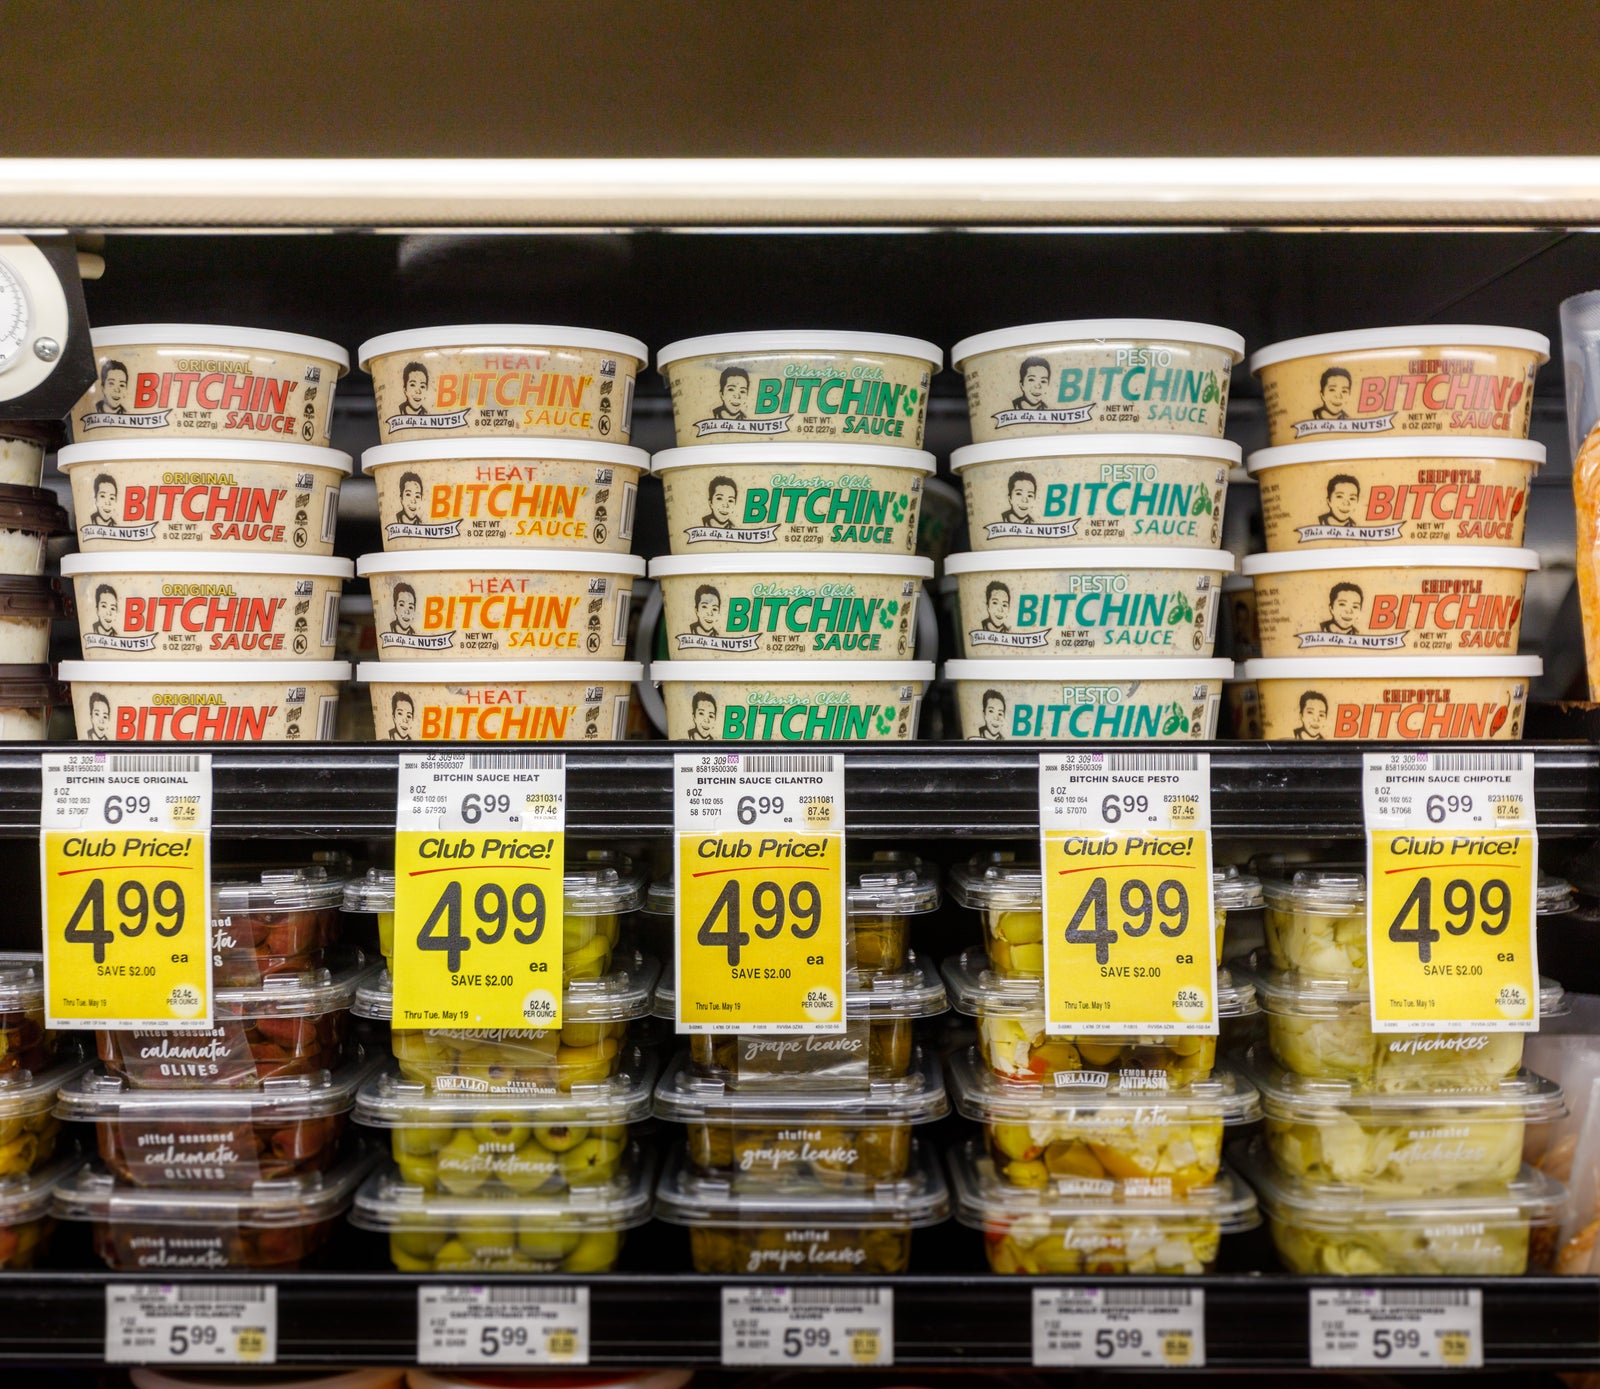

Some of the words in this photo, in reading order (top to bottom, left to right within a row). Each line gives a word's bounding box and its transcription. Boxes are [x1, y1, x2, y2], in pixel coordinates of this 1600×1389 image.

[178, 359, 252, 374] ORIGINAL
[484, 355, 544, 370] HEAT
[1116, 349, 1172, 367] PESTO
[784, 364, 847, 379] Cilantro
[852, 366, 884, 381] Chili
[1409, 360, 1475, 374] CHIPOTLE
[134, 372, 298, 414] BITCHIN'
[435, 372, 593, 409] BITCHIN'
[1058, 366, 1210, 403] BITCHIN'
[754, 378, 906, 417] BITCHIN'
[1357, 374, 1514, 413] BITCHIN'
[225, 411, 296, 434] SAUCE
[524, 409, 591, 428] SAUCE
[1001, 413, 1018, 423] This
[1021, 412, 1034, 422] dip
[1038, 412, 1047, 421] is
[1051, 411, 1085, 421] NUTS!
[1148, 404, 1207, 424] SAUCE
[1449, 411, 1510, 430] SAUCE
[843, 416, 904, 437] SAUCE
[163, 473, 237, 486] ORIGINAL
[477, 466, 537, 481] HEAT
[770, 474, 833, 488] Cilantro
[839, 475, 872, 489] Chili
[1101, 464, 1158, 482] PESTO
[1418, 469, 1481, 484] CHIPOTLE
[123, 486, 287, 523] BITCHIN'
[429, 483, 589, 519] BITCHIN'
[743, 488, 896, 525] BITCHIN'
[1043, 482, 1199, 517] BITCHIN'
[1366, 485, 1516, 521] BITCHIN'
[210, 523, 285, 542] SAUCE
[515, 521, 586, 538] SAUCE
[831, 525, 893, 543] SAUCE
[1133, 519, 1196, 536] SAUCE
[1457, 522, 1513, 539] SAUCE
[162, 584, 236, 596] ORIGINAL
[469, 578, 530, 593] HEAT
[752, 583, 816, 597] Cilantro
[820, 583, 856, 597] Chili
[1069, 575, 1128, 592] PESTO
[1422, 580, 1482, 594] CHIPOTLE
[124, 597, 286, 632] BITCHIN'
[422, 596, 580, 630] BITCHIN'
[726, 597, 884, 633] BITCHIN'
[1017, 593, 1176, 626] BITCHIN'
[1369, 594, 1514, 630] BITCHIN'
[210, 633, 284, 650] SAUCE
[478, 641, 499, 650] (227g)
[507, 631, 579, 648] SAUCE
[813, 633, 881, 650] SAUCE
[1104, 630, 1173, 645] SAUCE
[1459, 631, 1511, 648] SAUCE
[152, 694, 226, 705] ORIGINAL
[467, 690, 527, 704] HEAT
[746, 692, 810, 705] Cilantro
[815, 692, 851, 705] Chili
[1063, 687, 1122, 705] PESTO
[1383, 689, 1451, 703] CHIPOTLE
[116, 706, 278, 741] BITCHIN'
[420, 706, 577, 740] BITCHIN'
[722, 705, 880, 739] BITCHIN'
[1011, 704, 1171, 737] BITCHIN'
[1333, 703, 1497, 739] BITCHIN'
[433, 774, 473, 782] BITCHIN
[476, 774, 510, 782] SAUCE
[697, 777, 736, 785] BITCHIN
[739, 777, 771, 785] SAUCE
[775, 777, 823, 785] CILANTRO
[526, 794, 562, 802] 82310314
[799, 796, 834, 804] 82311081
[534, 806, 557, 815] 87.4¢
[808, 807, 830, 817] 87.4¢
[63, 838, 116, 857] Club
[123, 838, 192, 857] Price!
[419, 838, 475, 859] Club
[481, 838, 554, 859] Price!
[697, 838, 752, 858] Club
[759, 839, 828, 858] Price!
[1063, 837, 1118, 856] Club
[1125, 838, 1193, 856] Price!
[1390, 836, 1444, 855] Club
[1451, 837, 1520, 855] Price!
[97, 966, 126, 976] SAVE
[129, 966, 156, 977] $2.00
[530, 961, 547, 972] ea
[731, 969, 761, 979] SAVE
[764, 968, 791, 980] $2.00
[1100, 967, 1130, 977] SAVE
[1134, 966, 1161, 978] $2.00
[1424, 965, 1453, 976] SAVE
[1456, 965, 1482, 976] $2.00
[451, 975, 482, 986] SAVE
[485, 974, 513, 987] $2.00
[530, 1001, 550, 1010] 62.4¢
[808, 992, 827, 1002] 62.4¢
[443, 1011, 458, 1020] May
[523, 1010, 537, 1018] PER
[539, 1010, 556, 1018] OUNCE
[140, 1040, 232, 1060] calamata
[745, 1036, 802, 1060] grape
[806, 1034, 863, 1052] leaves
[1390, 1034, 1489, 1056] artichokes
[160, 1064, 218, 1076] OLIVES
[1120, 1069, 1146, 1077] LEMON
[1149, 1070, 1166, 1078] FETA
[1058, 1073, 1105, 1085] DELALLO
[1120, 1077, 1166, 1088] ANTIPASTI
[138, 1133, 174, 1146] pitted
[179, 1132, 234, 1144] seasoned
[778, 1130, 822, 1140] stuffed
[145, 1144, 239, 1164] calamata
[740, 1147, 798, 1170] grape
[802, 1144, 858, 1164] leaves
